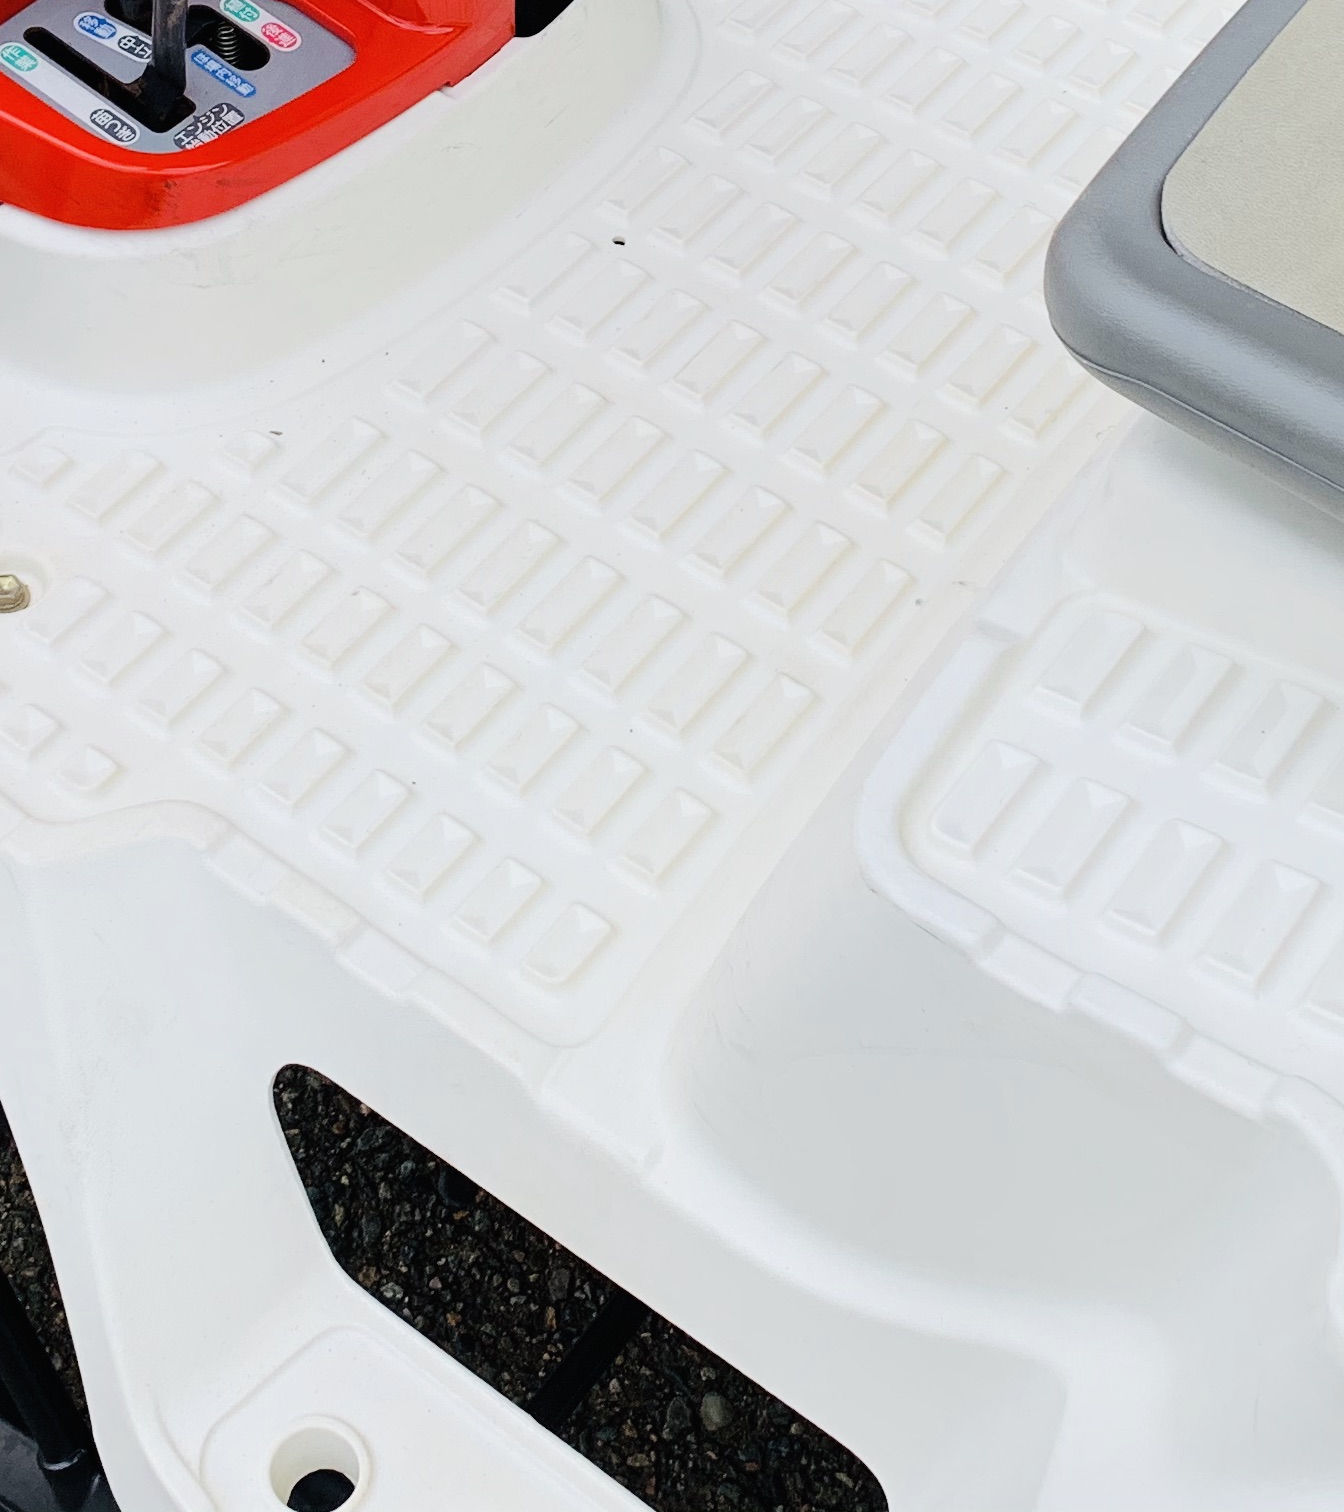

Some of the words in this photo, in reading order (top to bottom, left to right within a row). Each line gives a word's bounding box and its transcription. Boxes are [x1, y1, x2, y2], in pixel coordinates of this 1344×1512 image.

[78, 15, 116, 39] 移動
[261, 24, 296, 49] 後進
[2, 45, 38, 71] 作業
[120, 35, 153, 59] 中立
[91, 109, 135, 142] 苗つぎ
[174, 104, 228, 145] エンジン
